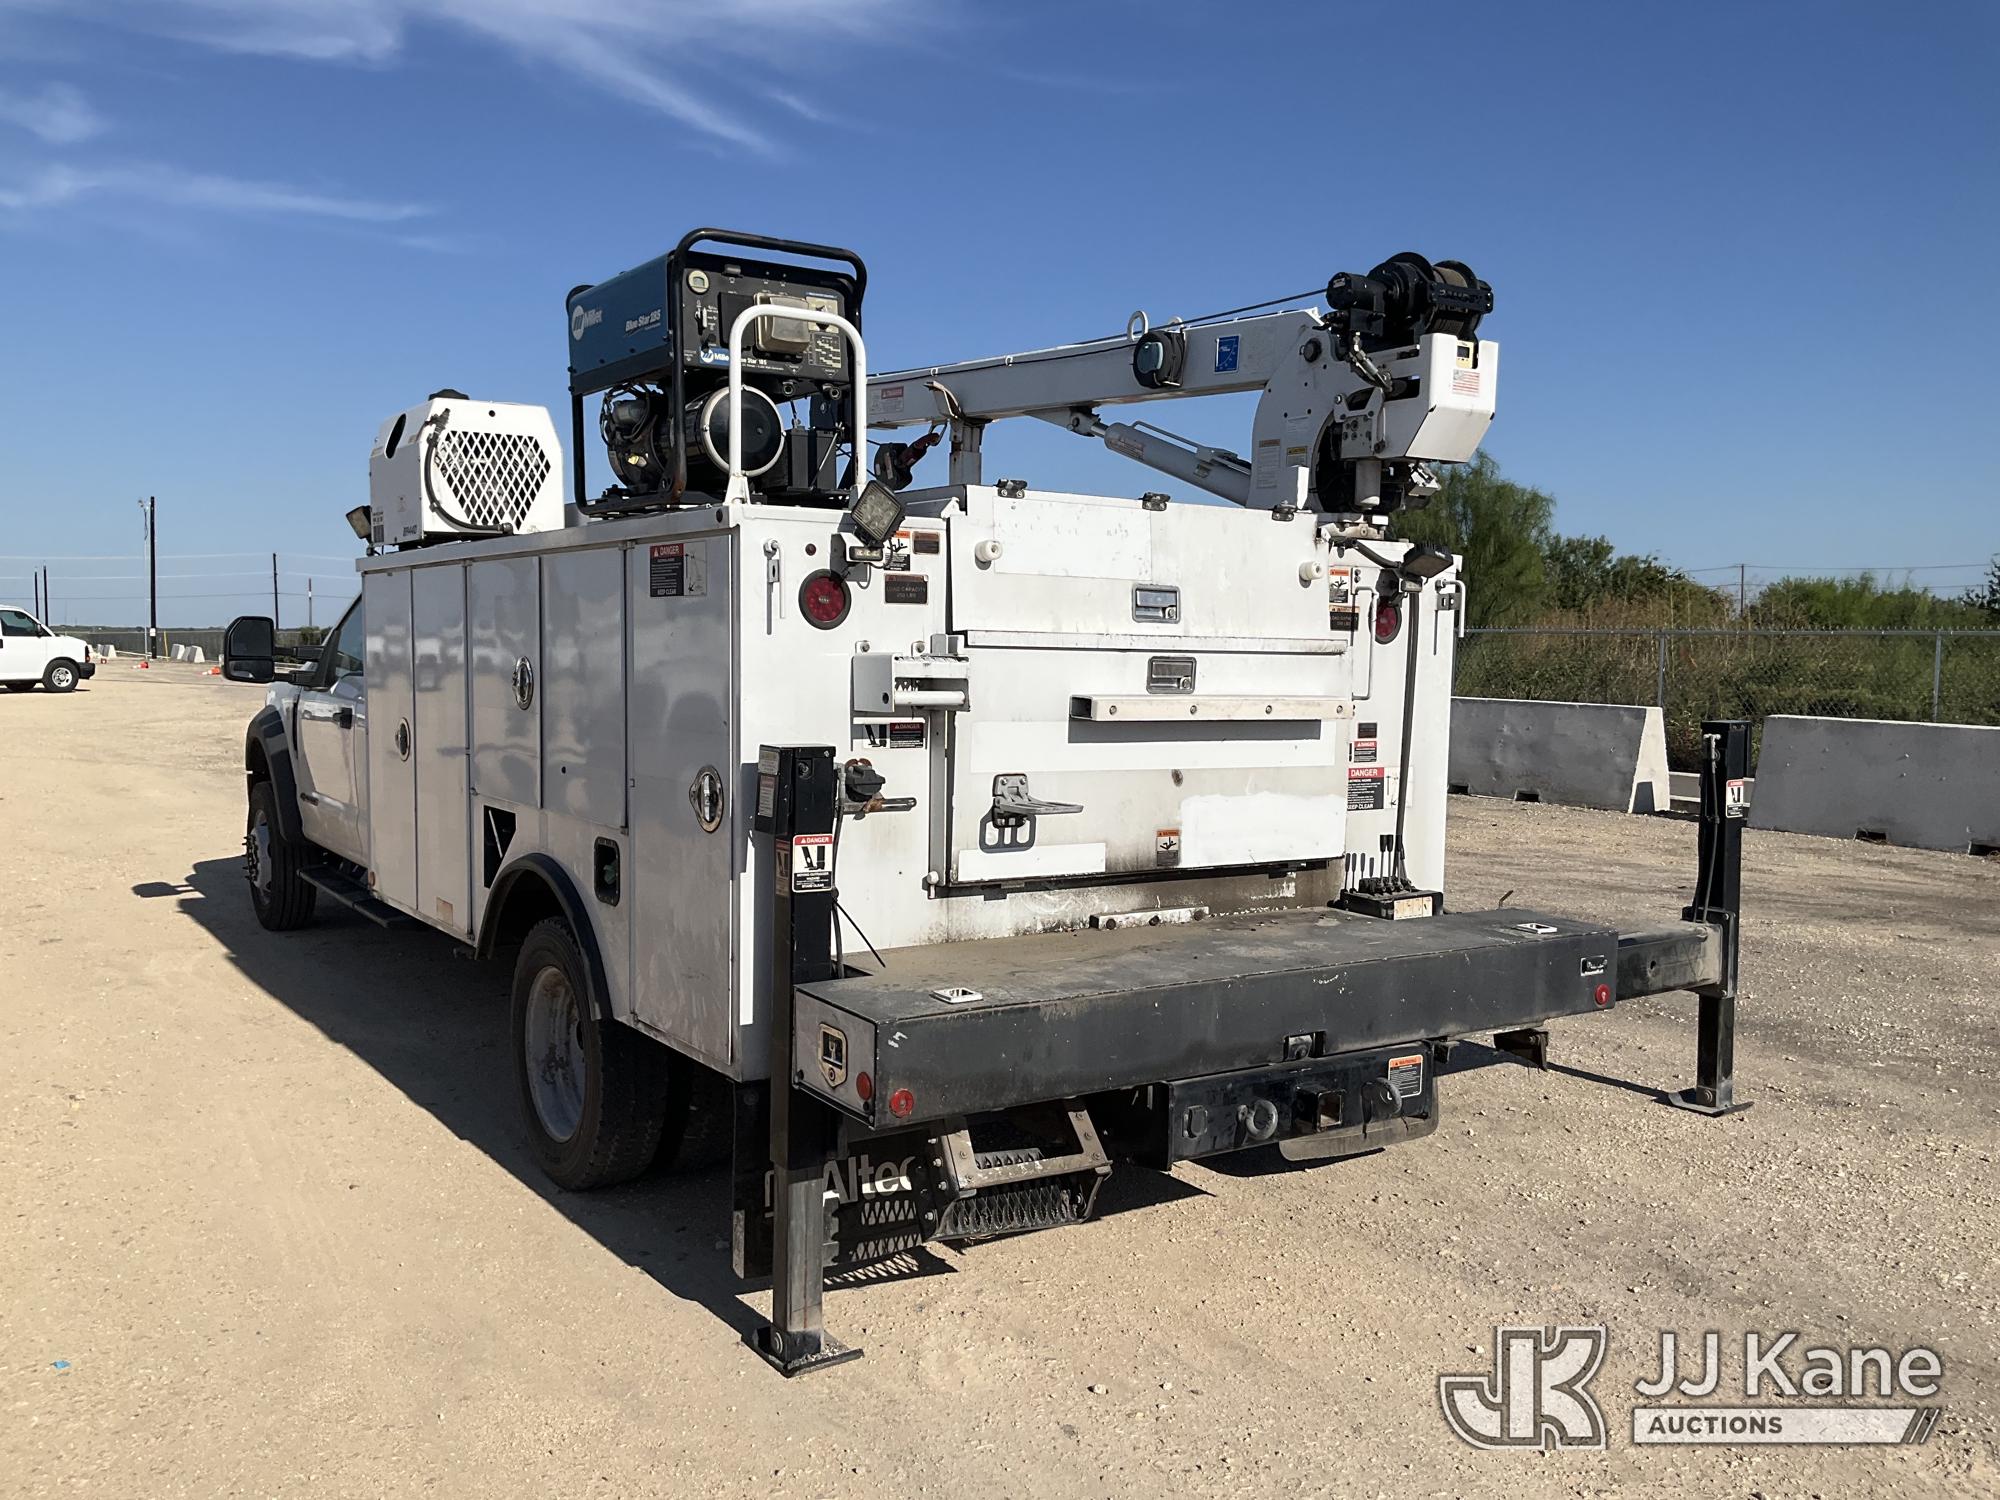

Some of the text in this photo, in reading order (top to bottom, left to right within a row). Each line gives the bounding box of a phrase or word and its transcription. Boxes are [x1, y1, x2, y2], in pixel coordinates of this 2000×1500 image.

[714, 353, 730, 362] Mille
[659, 545, 680, 556] DANGER
[1350, 768, 1378, 778] DANGER
